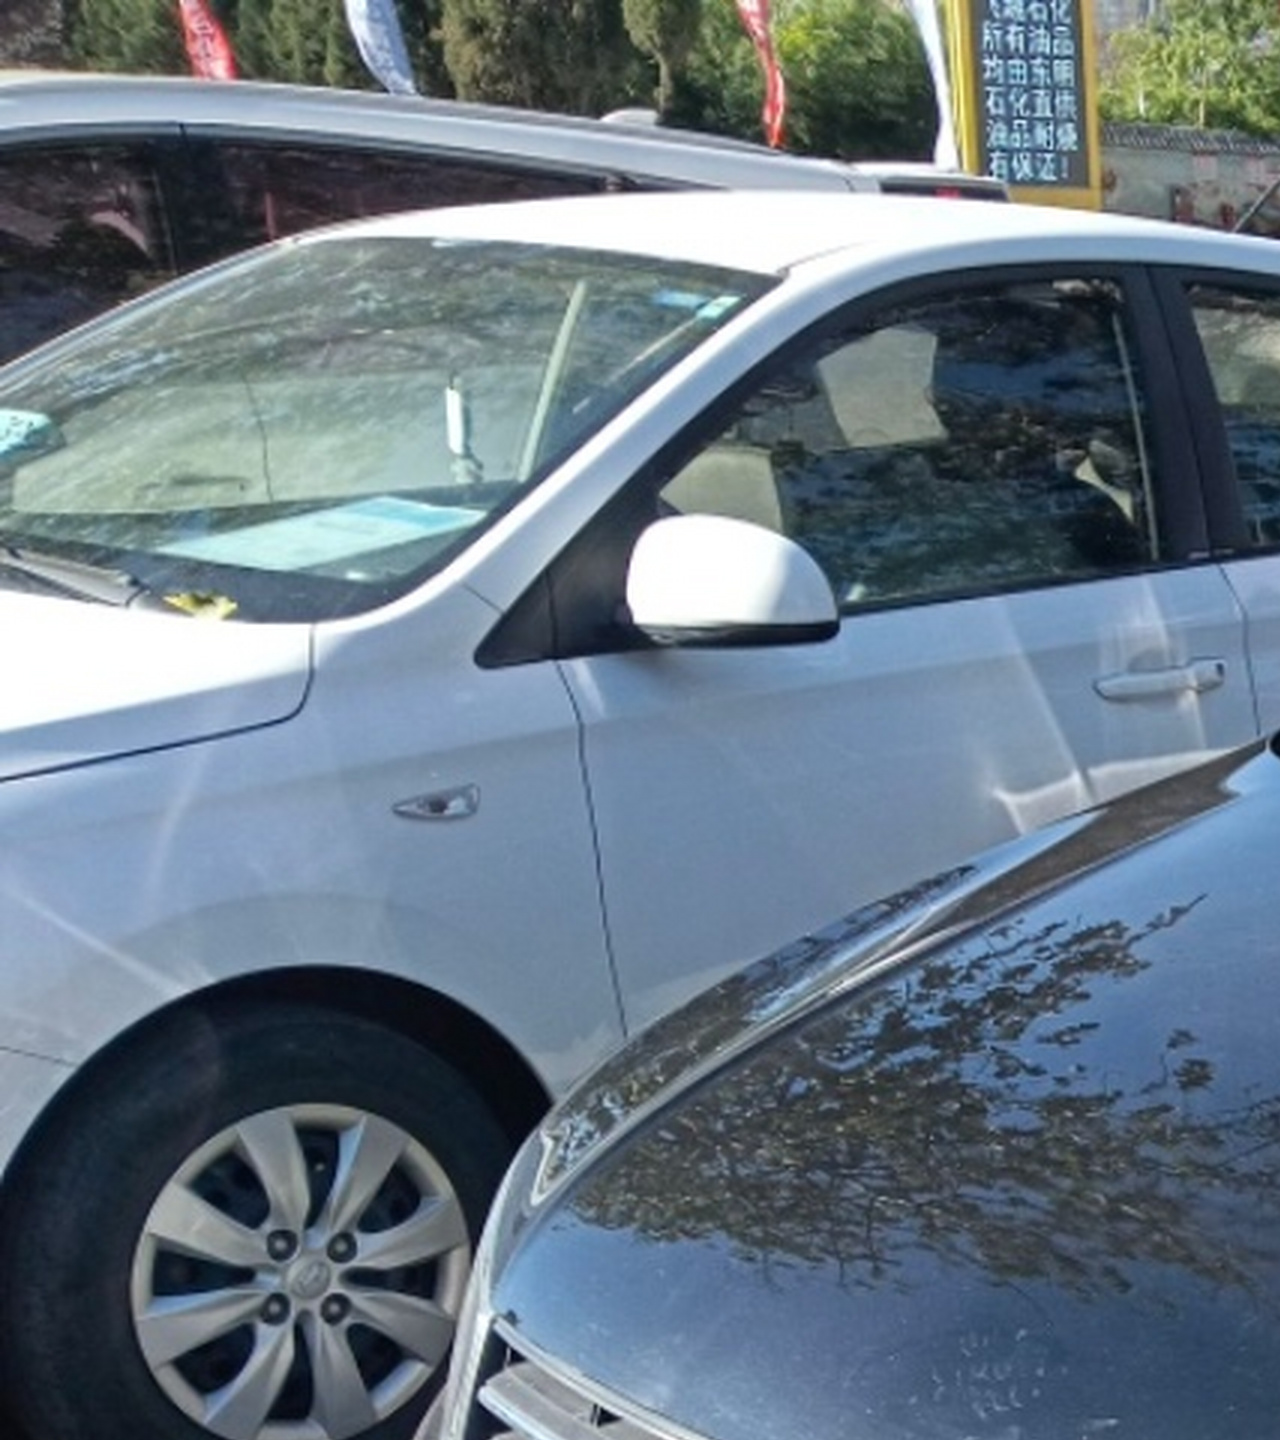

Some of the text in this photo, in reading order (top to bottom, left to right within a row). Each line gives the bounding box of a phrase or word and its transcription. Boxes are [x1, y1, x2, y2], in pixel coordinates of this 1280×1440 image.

[983, 21, 1074, 55] 所有油品
[982, 53, 1075, 87] 均由东明
[985, 86, 1077, 119] 石化直供
[986, 119, 1078, 151] 油品耐烧
